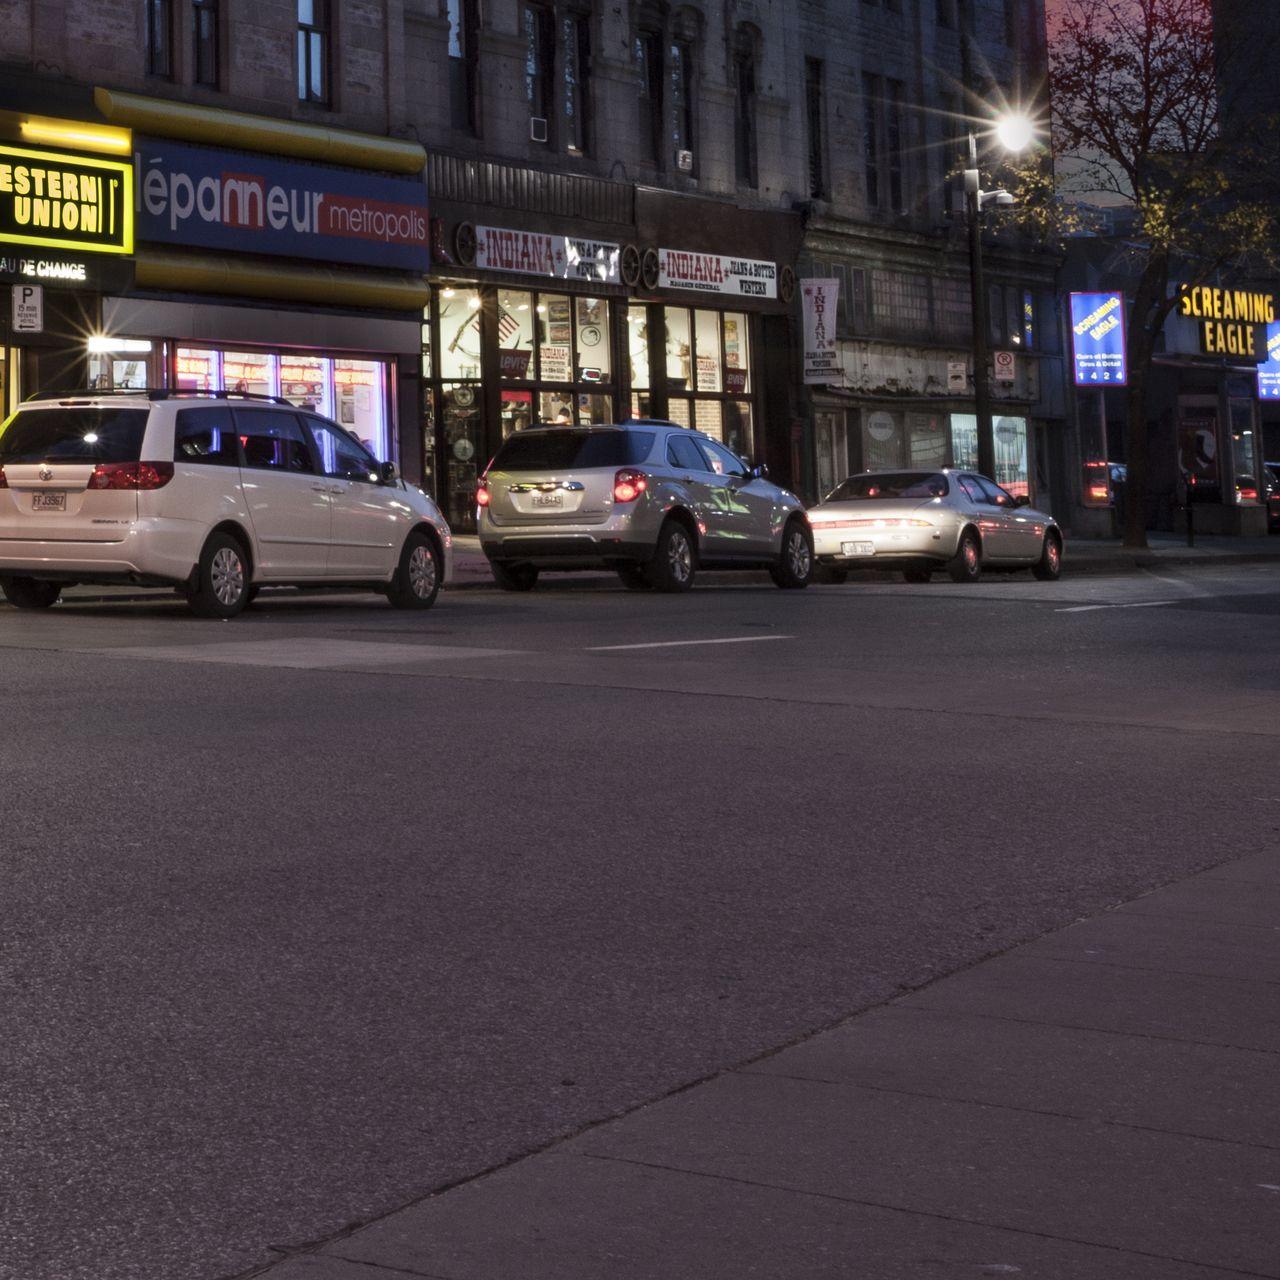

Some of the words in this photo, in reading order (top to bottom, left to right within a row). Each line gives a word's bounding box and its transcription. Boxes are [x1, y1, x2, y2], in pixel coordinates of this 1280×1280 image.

[14, 196, 97, 233] UNION
[329, 204, 426, 241] metropolis
[485, 230, 556, 273] INDIANA
[666, 251, 724, 283] INDIANA
[20, 259, 36, 276] DE
[36, 261, 87, 281] CHANGE
[730, 261, 748, 276] JEANS
[753, 264, 775, 279] BOTTES
[739, 279, 767, 296] WESTERN
[23, 288, 33, 303] P
[1181, 284, 1274, 324] SCREAMING
[814, 286, 826, 349] INDIANA
[1074, 297, 1120, 335] SCREAMING
[1089, 314, 1120, 341] EAGLE
[1205, 321, 1255, 356] EAGLE
